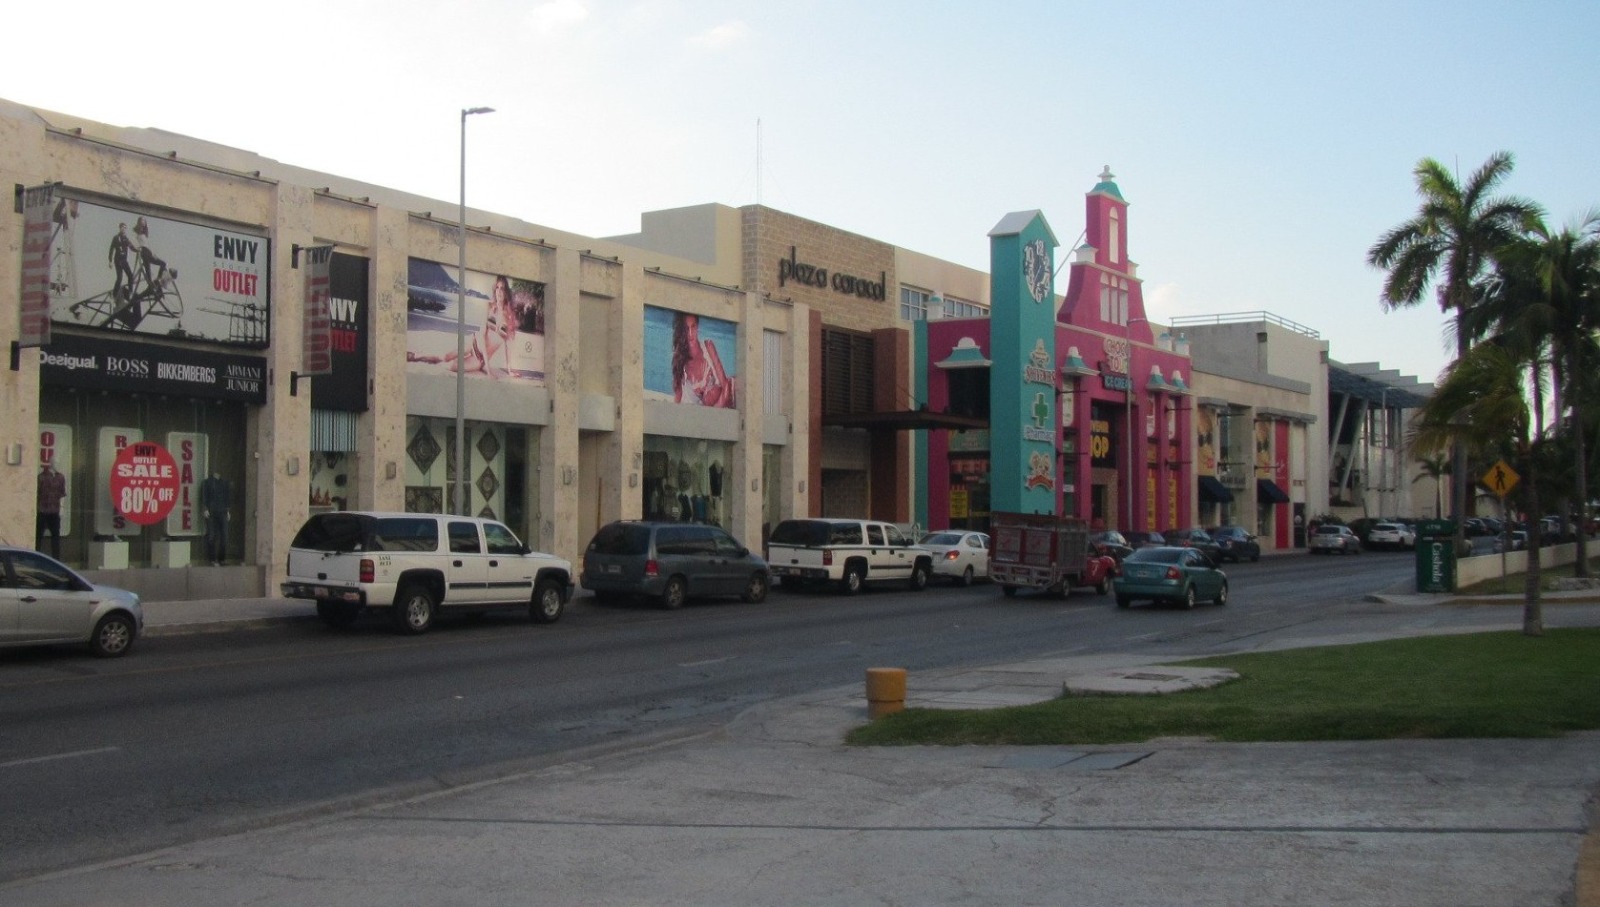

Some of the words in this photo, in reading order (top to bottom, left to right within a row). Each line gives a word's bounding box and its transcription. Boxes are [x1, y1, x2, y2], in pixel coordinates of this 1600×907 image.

[214, 234, 258, 264] ENVY
[213, 268, 258, 296] OUTLET
[780, 246, 827, 287] plaza
[832, 271, 885, 301] caracol
[330, 297, 358, 323] NVY
[107, 357, 149, 374] BOSS
[157, 362, 216, 384] BIKKEMBERGS
[227, 364, 261, 379] ARMANI
[226, 379, 260, 393] JUNIOR
[135, 445, 157, 456] ENVY
[117, 463, 173, 478] SALE
[181, 440, 193, 530] SALE
[121, 486, 158, 513] 80%
[159, 488, 174, 501] OFF
